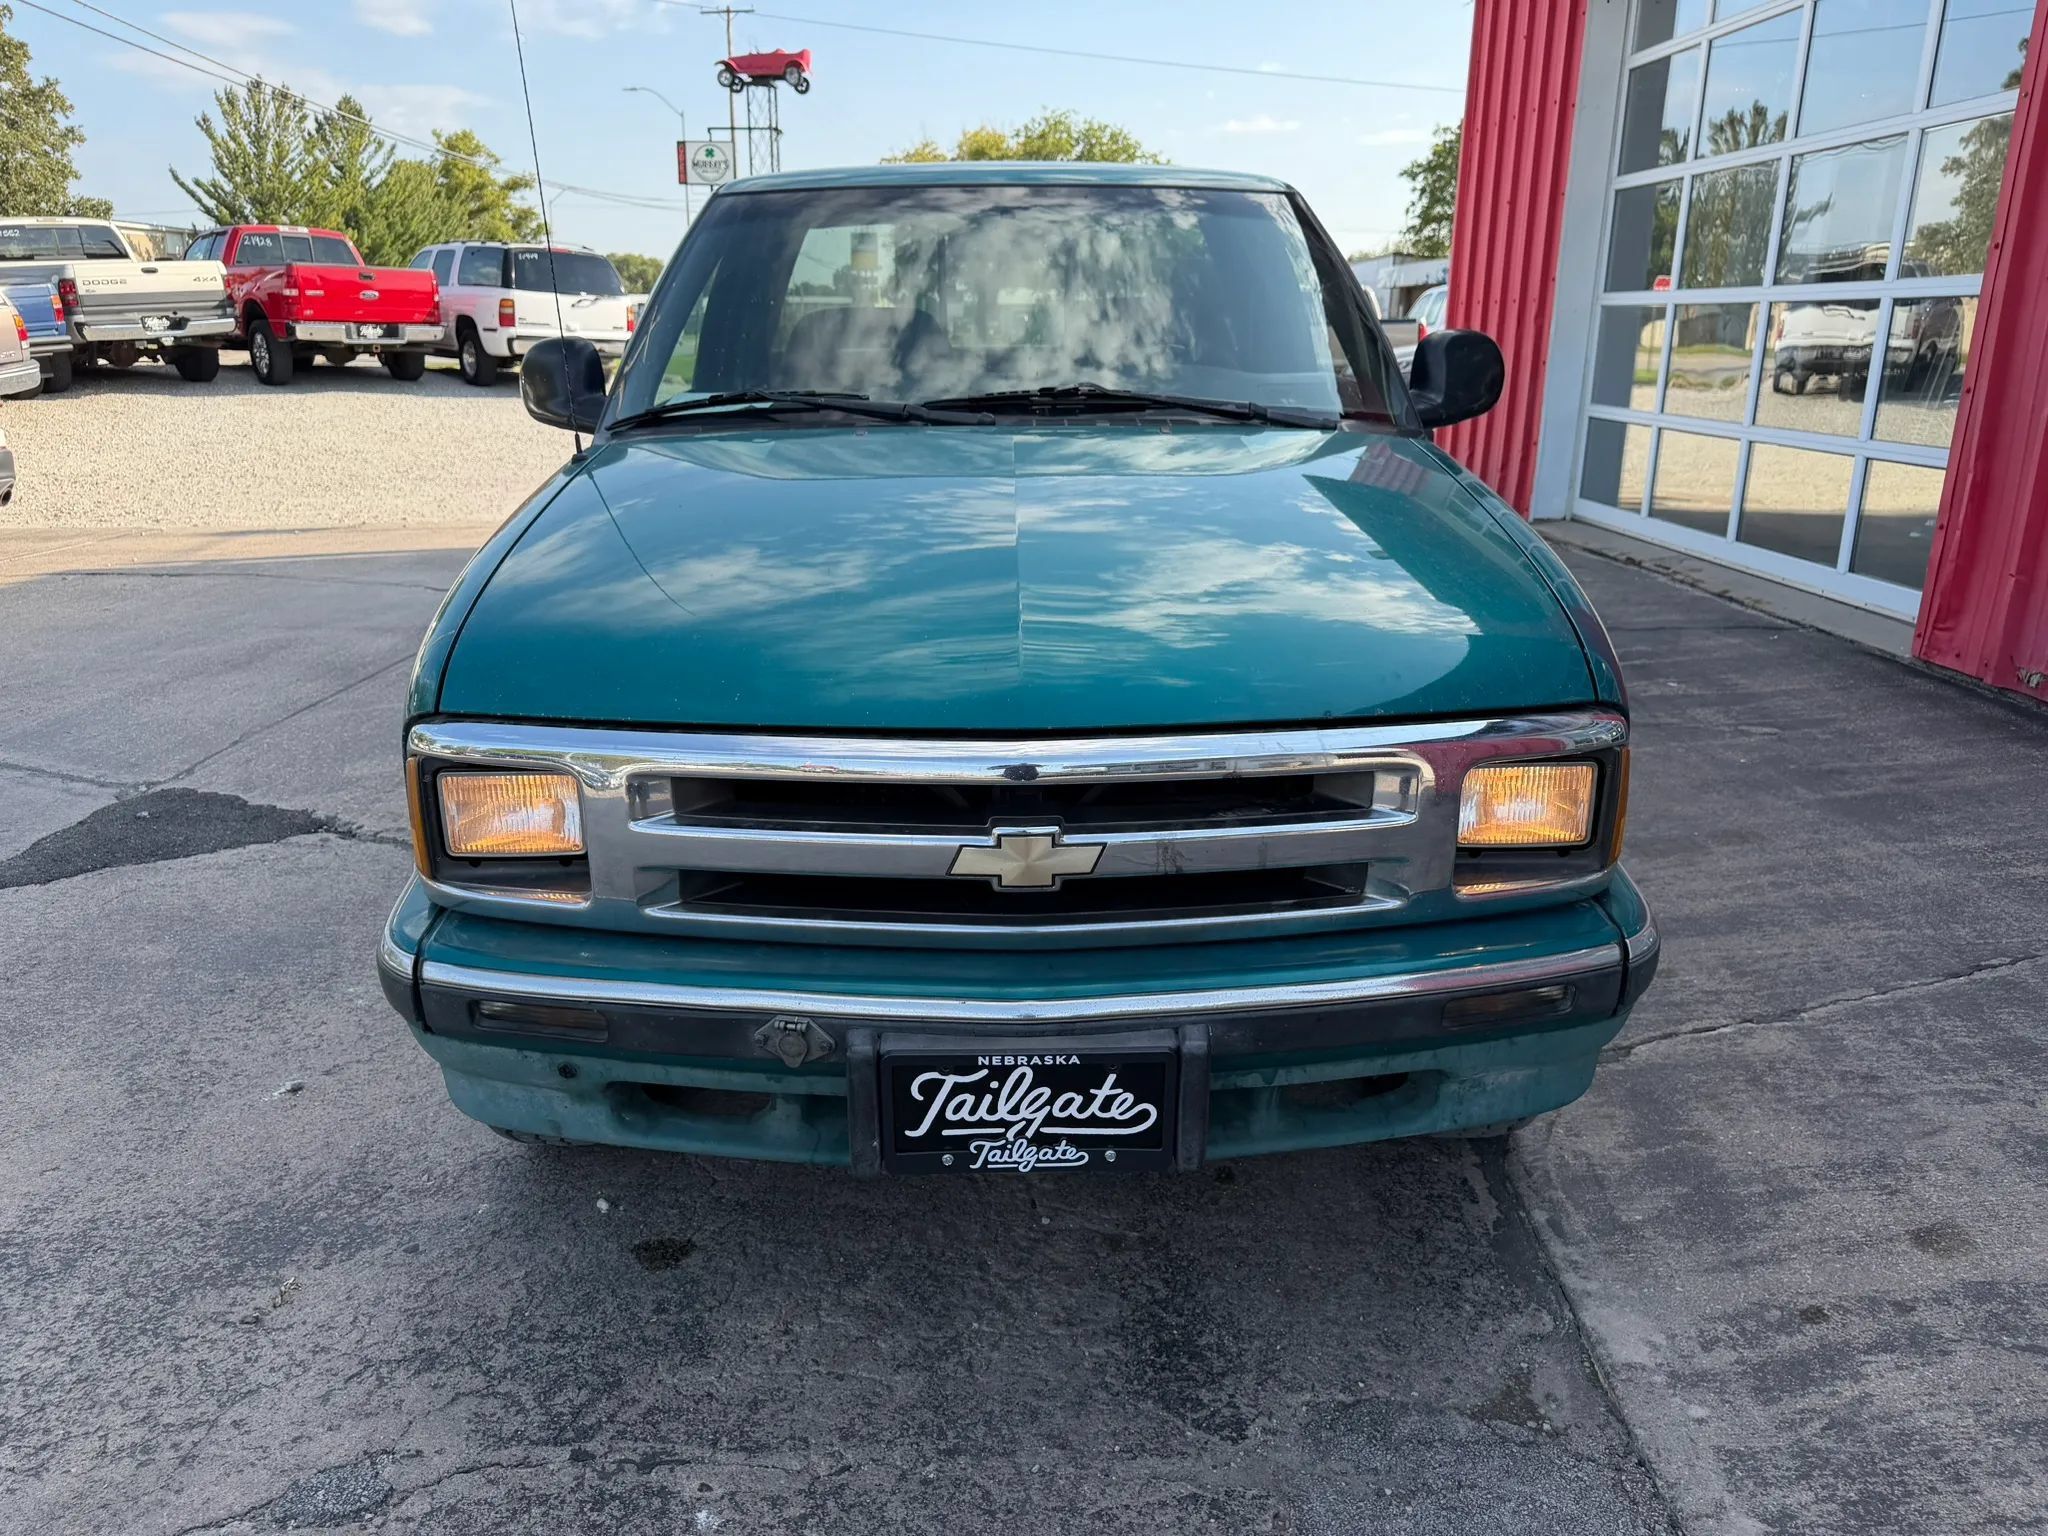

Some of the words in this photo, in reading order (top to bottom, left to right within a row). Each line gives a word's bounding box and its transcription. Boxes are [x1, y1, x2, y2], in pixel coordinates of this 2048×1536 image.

[978, 1055, 1081, 1066] NEBRASKA
[904, 1066, 1158, 1141] Tailgate
[969, 1138, 1089, 1172] Tailgate
